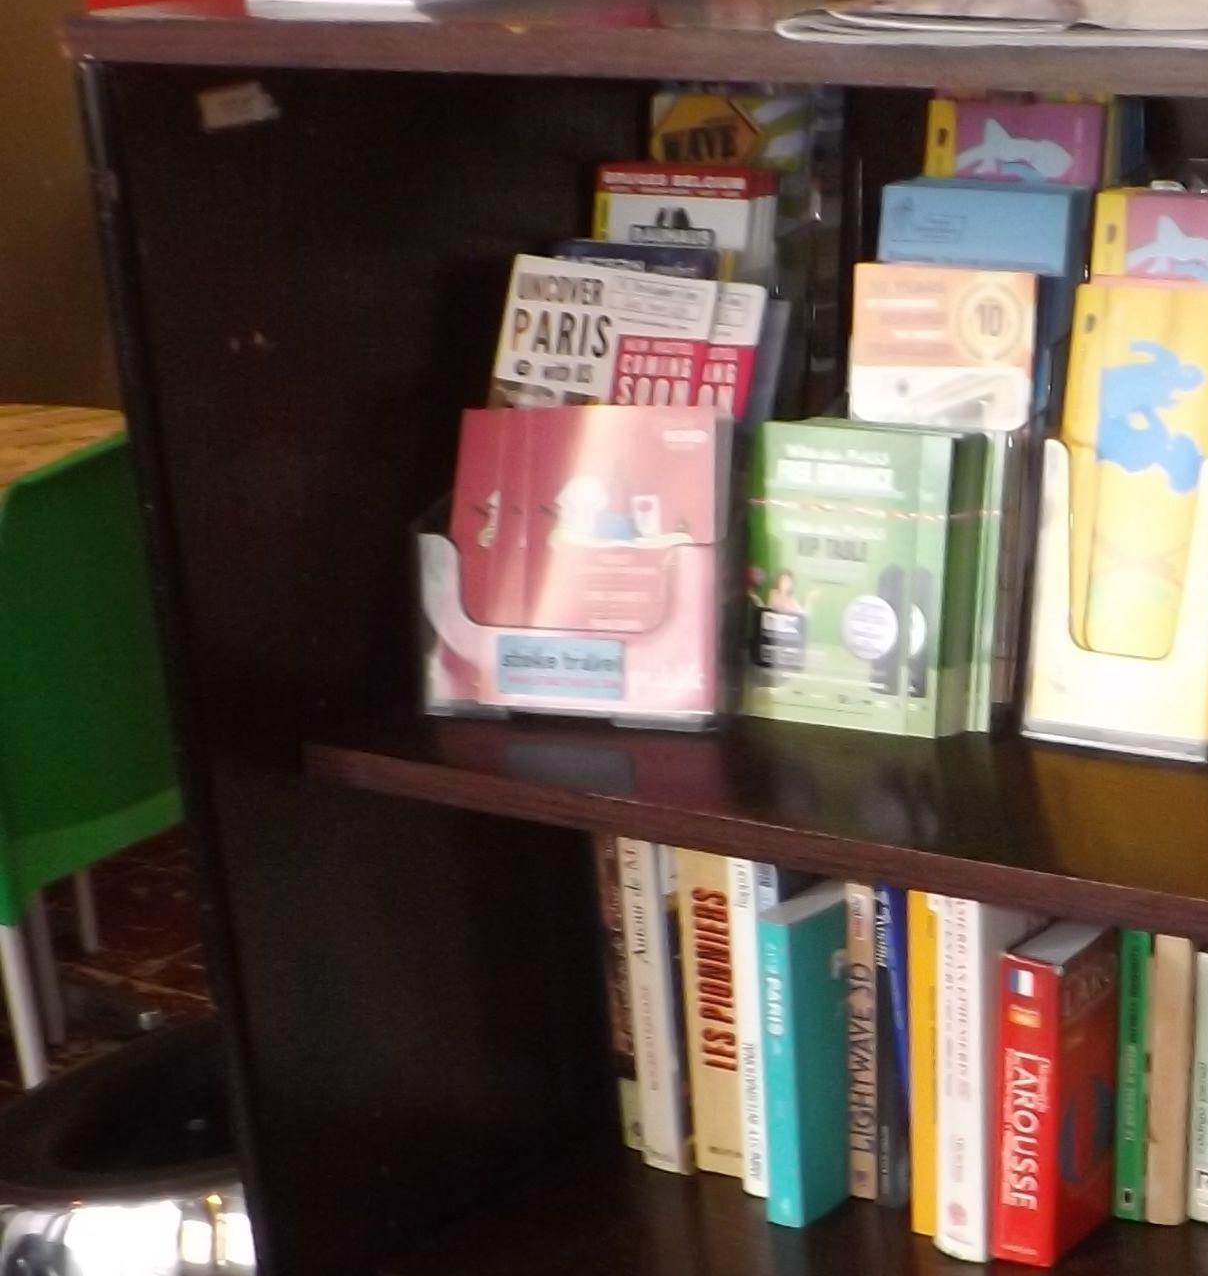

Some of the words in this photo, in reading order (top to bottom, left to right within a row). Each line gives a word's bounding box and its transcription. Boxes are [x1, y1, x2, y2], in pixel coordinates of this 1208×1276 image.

[510, 307, 613, 359] PARIS
[701, 1027, 739, 1072] LES
[848, 1000, 876, 1154] LIGHTWAVE
[1003, 1047, 1051, 1212] LAROUSSE
